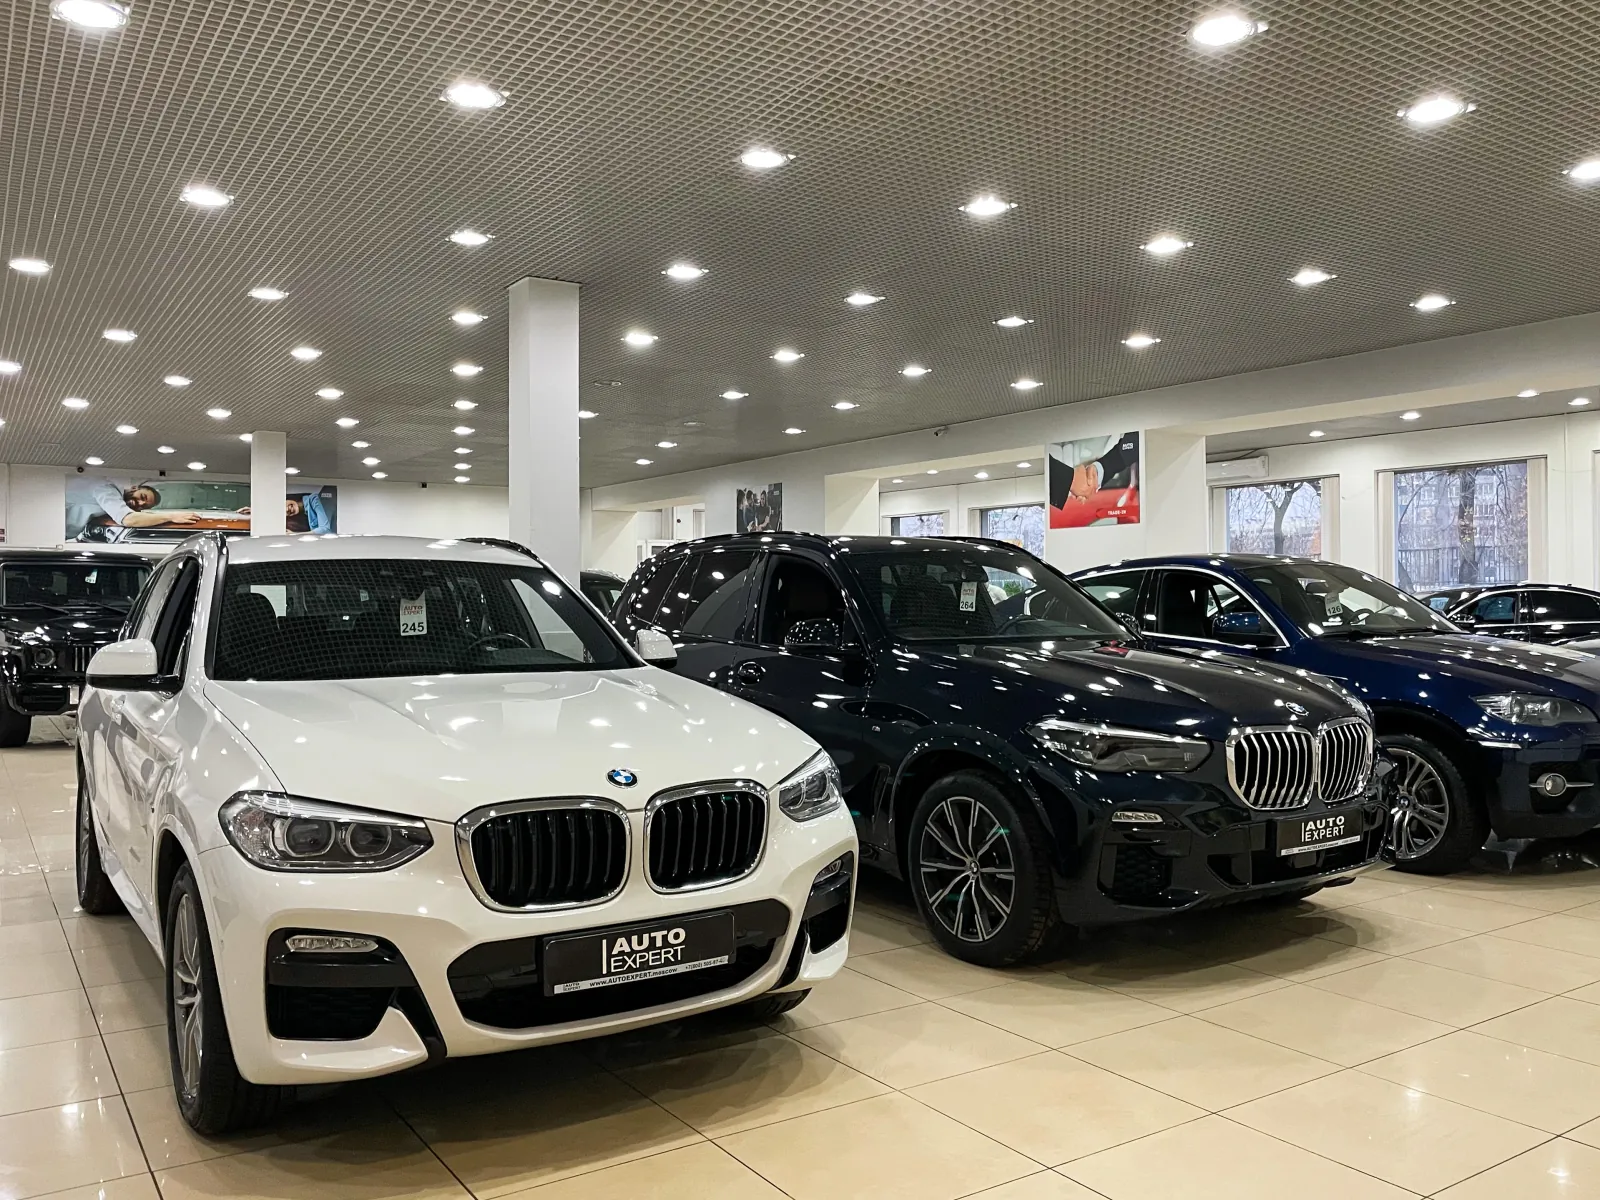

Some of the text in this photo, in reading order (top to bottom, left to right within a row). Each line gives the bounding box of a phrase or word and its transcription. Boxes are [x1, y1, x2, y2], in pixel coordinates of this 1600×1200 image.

[960, 601, 974, 609] 264
[1328, 605, 1341, 615] 126
[402, 621, 425, 633] 245
[1305, 815, 1345, 831] AUTO
[1305, 825, 1345, 842] EXPERT
[611, 927, 686, 955] AUTO
[610, 945, 686, 973] EXPERT
[590, 967, 678, 988] www.AUTOEXPERT.moscow
